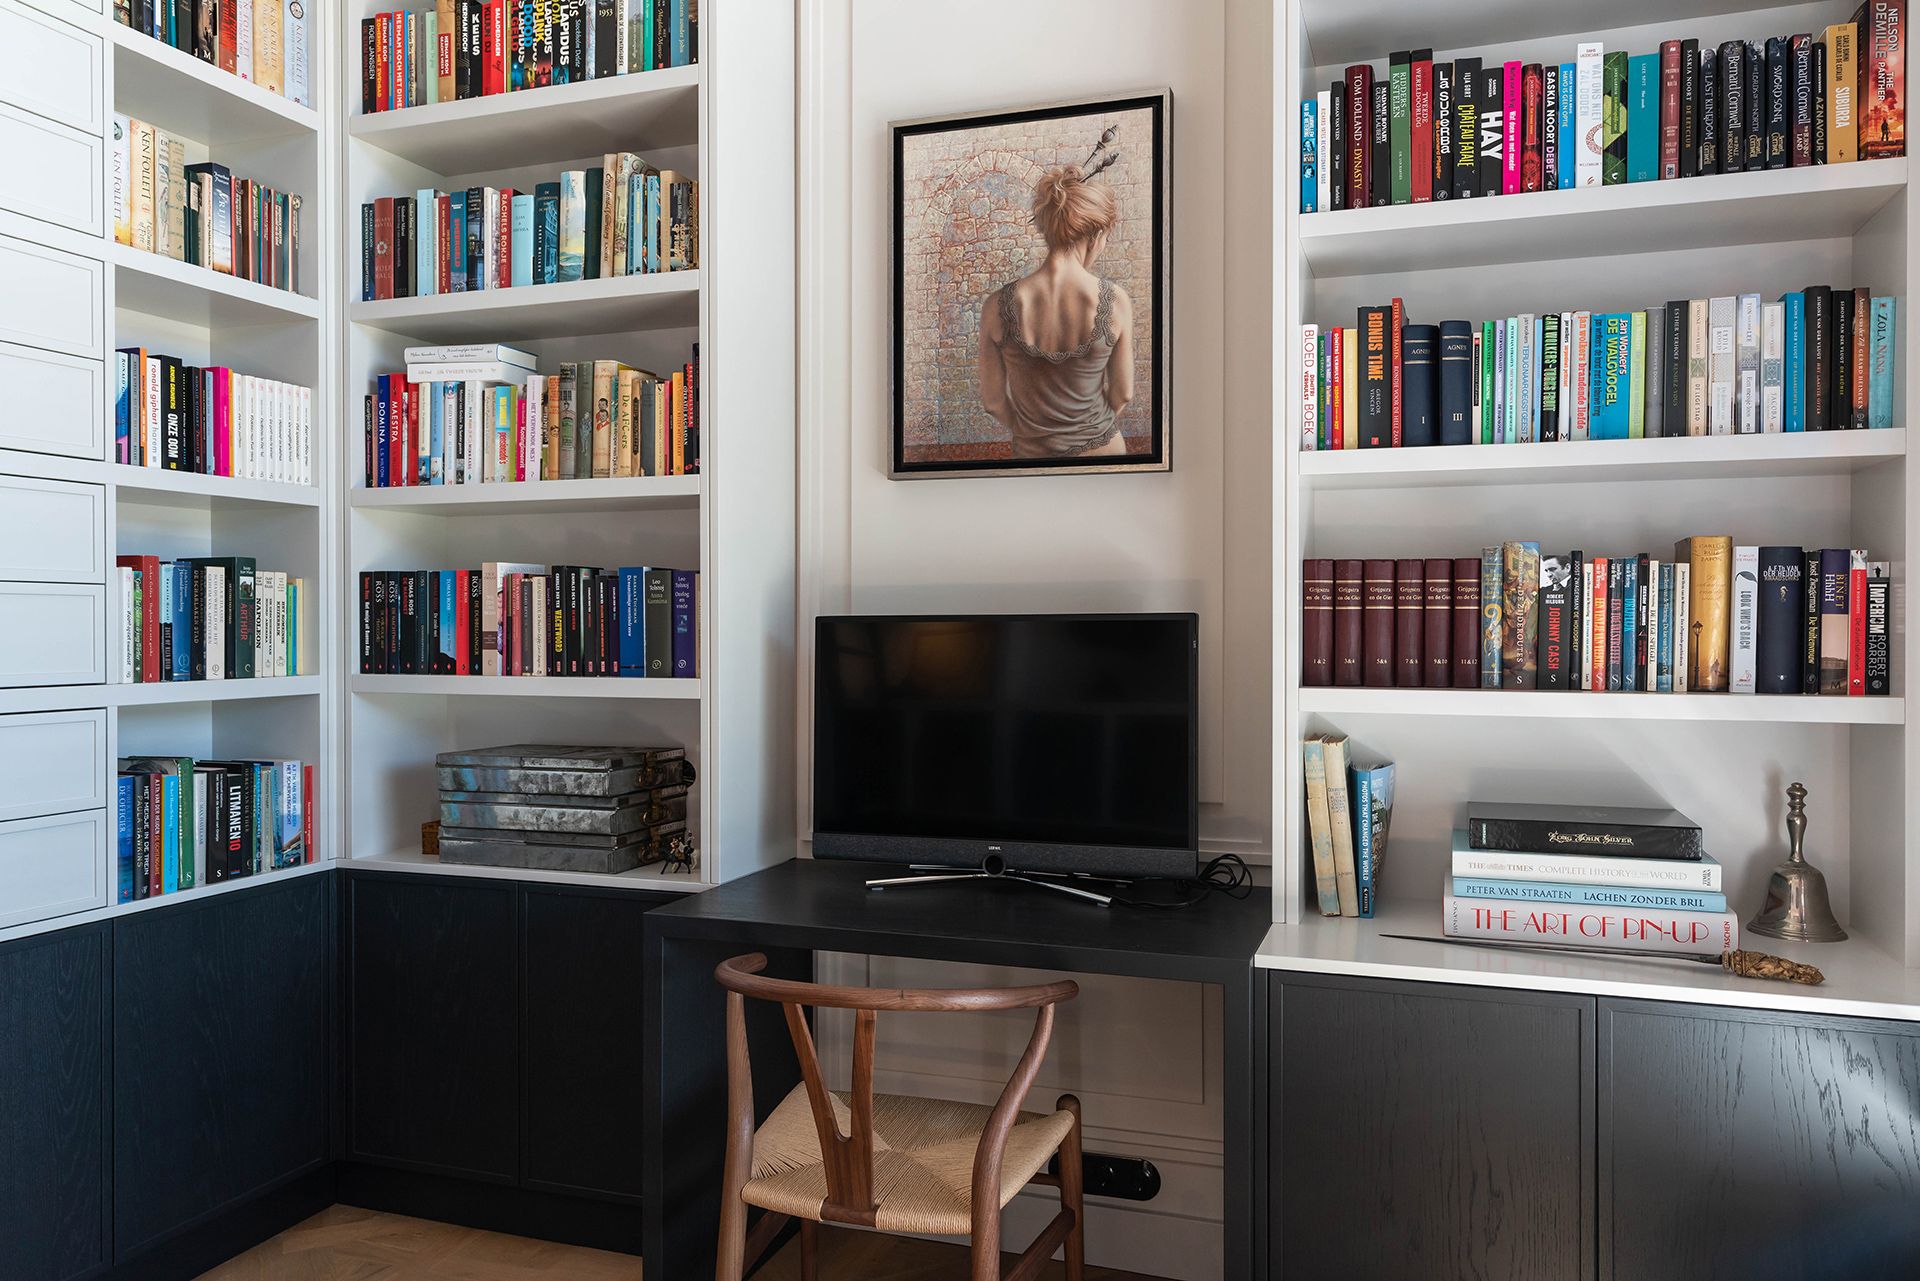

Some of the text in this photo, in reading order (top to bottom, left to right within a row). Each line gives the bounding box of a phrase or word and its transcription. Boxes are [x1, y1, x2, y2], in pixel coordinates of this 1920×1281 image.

[524, 4, 532, 47] DOOD
[544, 2, 552, 54] LAPIDUS
[598, 8, 614, 17] 1953
[1876, 2, 1887, 58] DEMILLE
[1888, 8, 1898, 51] NELSON
[472, 13, 480, 56] KEES
[511, 17, 519, 52] GELD
[560, 6, 570, 66] LAPIDUS
[1728, 56, 1740, 128] Bernard Cornwell
[1772, 65, 1782, 124] SWORD SONG
[1797, 50, 1810, 124] Bernard Cornwell
[1878, 62, 1886, 101] PANTHER
[1886, 72, 1894, 88] THE
[1546, 72, 1555, 174] SASKIA NOORT DEBET
[1704, 75, 1714, 140] LAST KINGDOM
[1836, 87, 1850, 128] SUBURRA
[1354, 74, 1362, 190] TOM HOLLAND DYNASTY
[1481, 111, 1502, 160] HAY
[141, 130, 150, 201] KEN FOLLETT
[1457, 142, 1475, 168] FATALE
[1368, 312, 1384, 380] BONUS TIME
[1606, 318, 1618, 334] DE
[1620, 318, 1628, 374] Jan Wolkers
[1876, 313, 1888, 374] ZOLA NANA
[151, 364, 159, 392] ronald
[1304, 330, 1314, 435] BLOED BOEK
[1521, 345, 1530, 435] TERUG NAAR OEGSTGEEST
[1577, 316, 1588, 429] jan wolkers brandende liefde
[150, 394, 158, 424] giphart
[622, 394, 630, 448] De AFC-ers
[167, 414, 178, 458] ONZE OOM
[1517, 590, 1524, 601] DE
[1825, 574, 1834, 602] HhhH
[1836, 574, 1844, 608] BINET
[1868, 584, 1888, 634] IMPERIUM
[240, 603, 248, 640] ARTHUR
[554, 610, 562, 652] WACHTWOORD
[1740, 590, 1752, 650] LOOK WHO'S BACK
[1808, 560, 1818, 664] Joost Zwagerman De buitenvrouw
[1548, 606, 1560, 669] JOHNNY CASH
[1868, 634, 1877, 676] HARRIS
[1878, 634, 1886, 676] ROBERT
[119, 786, 126, 798] DE
[144, 832, 150, 840] IN
[144, 842, 150, 853] DE
[1468, 862, 1534, 872] THE TIMES
[1538, 865, 1586, 876] COMPLETE
[1590, 868, 1631, 878] HISTORY
[1650, 871, 1687, 881] WORLD
[1466, 885, 1704, 908] PETER VAN STRAATEN LACHEN ZONDER BRIL
[1470, 908, 1516, 932] THE
[1523, 912, 1572, 936] ART
[1578, 914, 1615, 938] OF
[1623, 916, 1710, 944] PIN-UP
